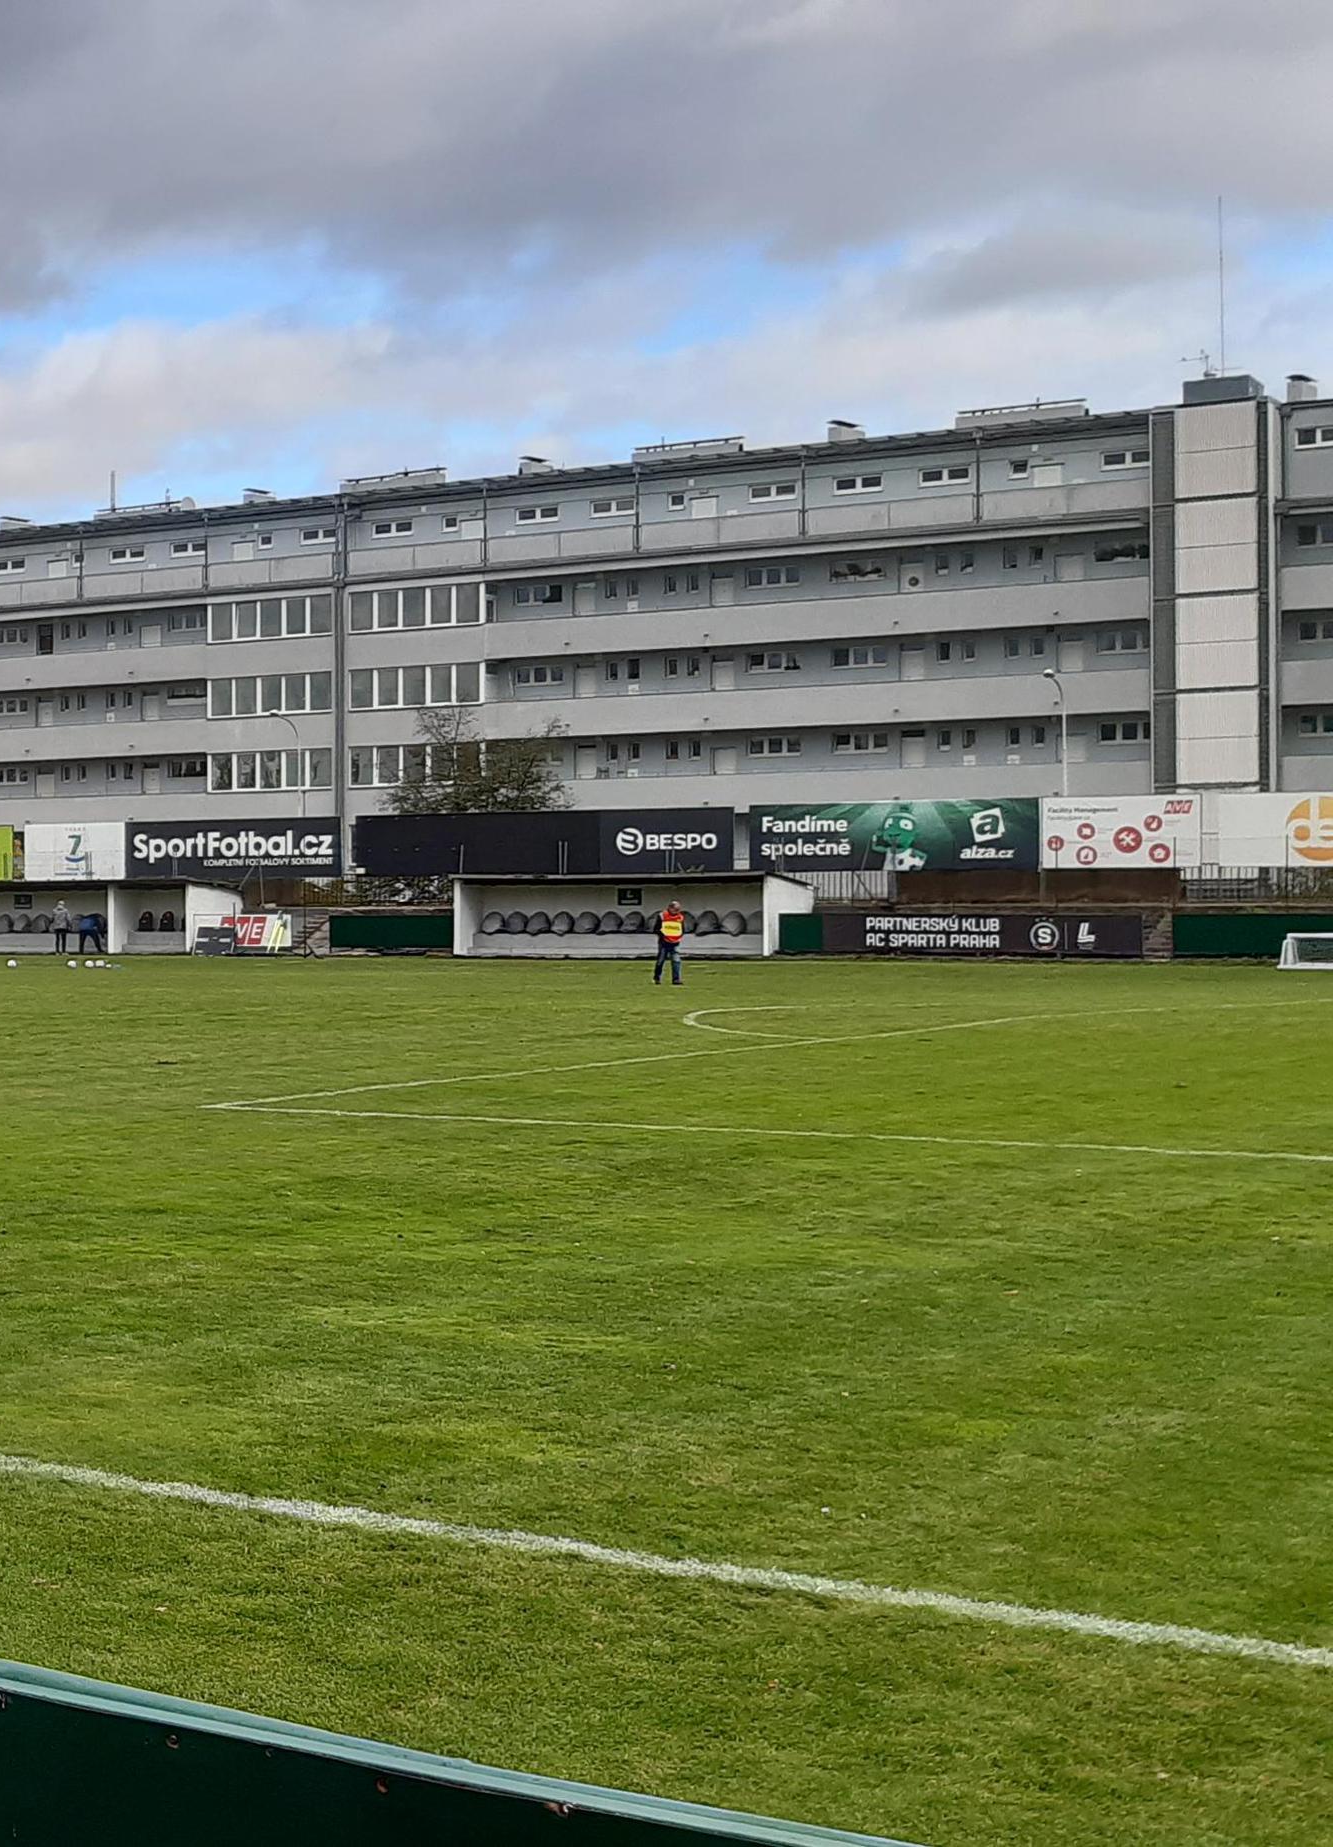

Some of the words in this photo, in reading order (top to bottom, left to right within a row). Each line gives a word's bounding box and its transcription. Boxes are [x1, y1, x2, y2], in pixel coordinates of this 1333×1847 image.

[762, 815, 848, 832] Fandíme
[68, 835, 82, 855] 7
[133, 830, 333, 863] SportFotbal.cz
[646, 833, 717, 850] BESPO
[761, 838, 851, 860] společně
[960, 845, 1015, 859] alza.cz
[866, 915, 958, 931] PARTNERSKÝ
[962, 918, 1000, 932] KLUB
[866, 933, 885, 946] AC
[889, 934, 946, 947] SPARTA
[950, 934, 1000, 948] PRAHA
